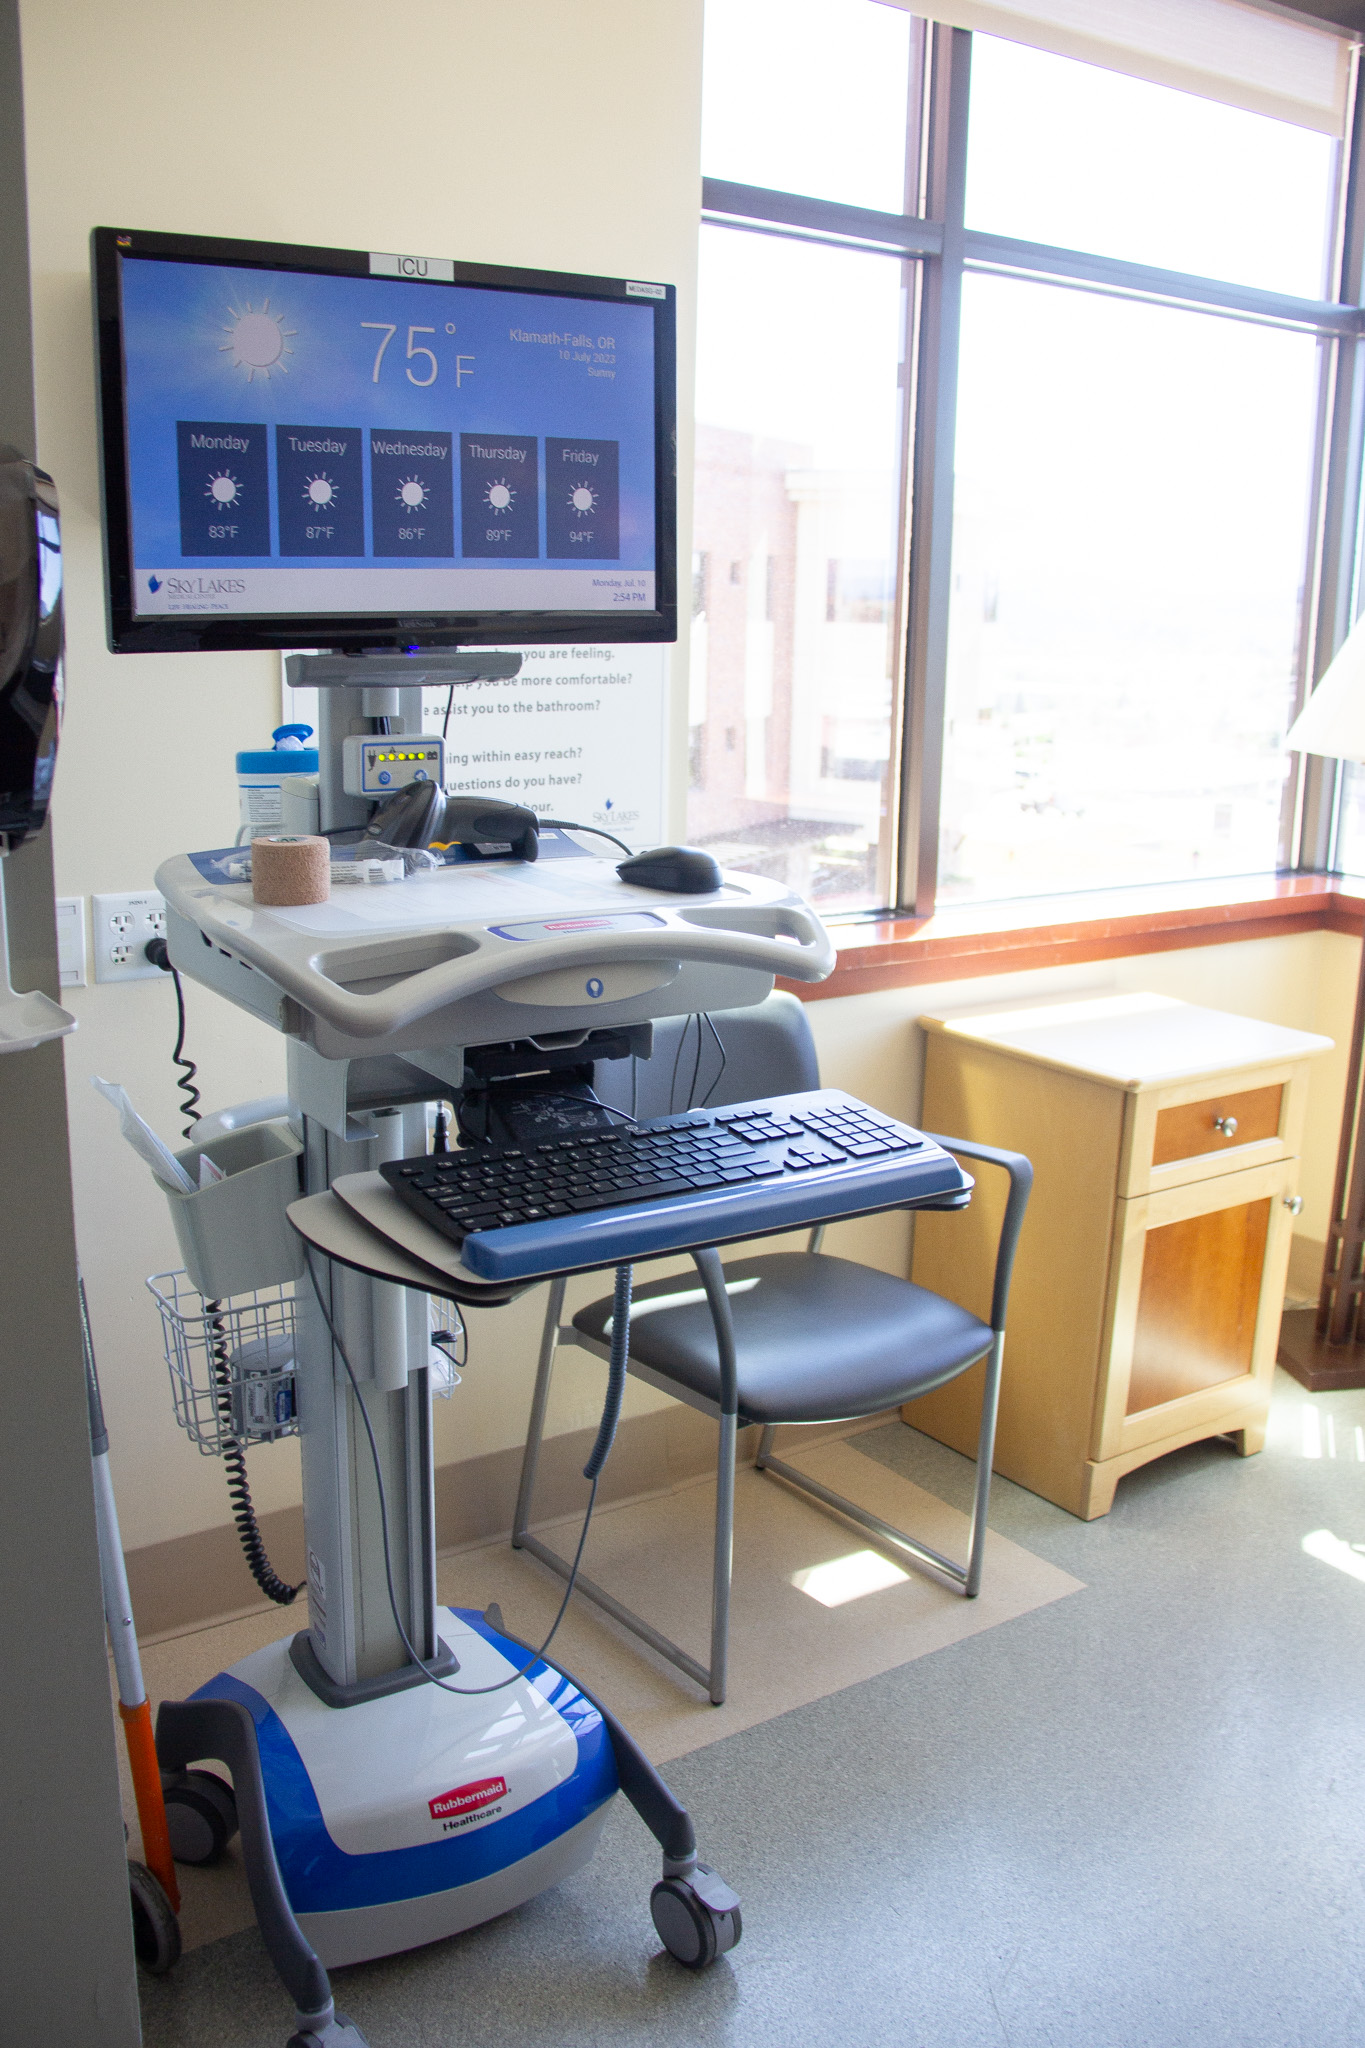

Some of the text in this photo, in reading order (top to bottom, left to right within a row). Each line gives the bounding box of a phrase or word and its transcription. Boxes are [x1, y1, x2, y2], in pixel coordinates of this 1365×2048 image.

[398, 257, 428, 276] ICU
[509, 329, 616, 350] Klamath-Falls, OR
[559, 350, 616, 364] 10 July 2023
[587, 367, 616, 380] Sunny
[191, 433, 249, 453] Monday
[288, 437, 347, 456] Tuesday
[372, 440, 447, 460] Wednesday
[468, 444, 527, 463] Thursday
[562, 449, 599, 467] Friday
[208, 525, 239, 539] 83°F
[305, 526, 335, 539] 87°F
[398, 528, 426, 540] 86°F
[486, 529, 512, 542] 89°F
[569, 531, 594, 543] 94°F
[167, 577, 246, 594] SKY LAKES
[592, 579, 622, 588] Monday,
[637, 579, 646, 587] 10
[613, 593, 646, 602] 2:54 PM
[524, 647, 615, 662] you are feeling.
[521, 676, 552, 686] more
[555, 672, 632, 686] comfortable?
[472, 704, 494, 717] you
[498, 702, 510, 713] to
[513, 701, 533, 712] the
[537, 699, 601, 712] bathroom?
[446, 747, 583, 767] ing within easy reach?
[447, 773, 582, 791] uestions do you have?
[433, 1782, 503, 1814] Rubbermaid
[442, 1805, 502, 1831] Healthcare
